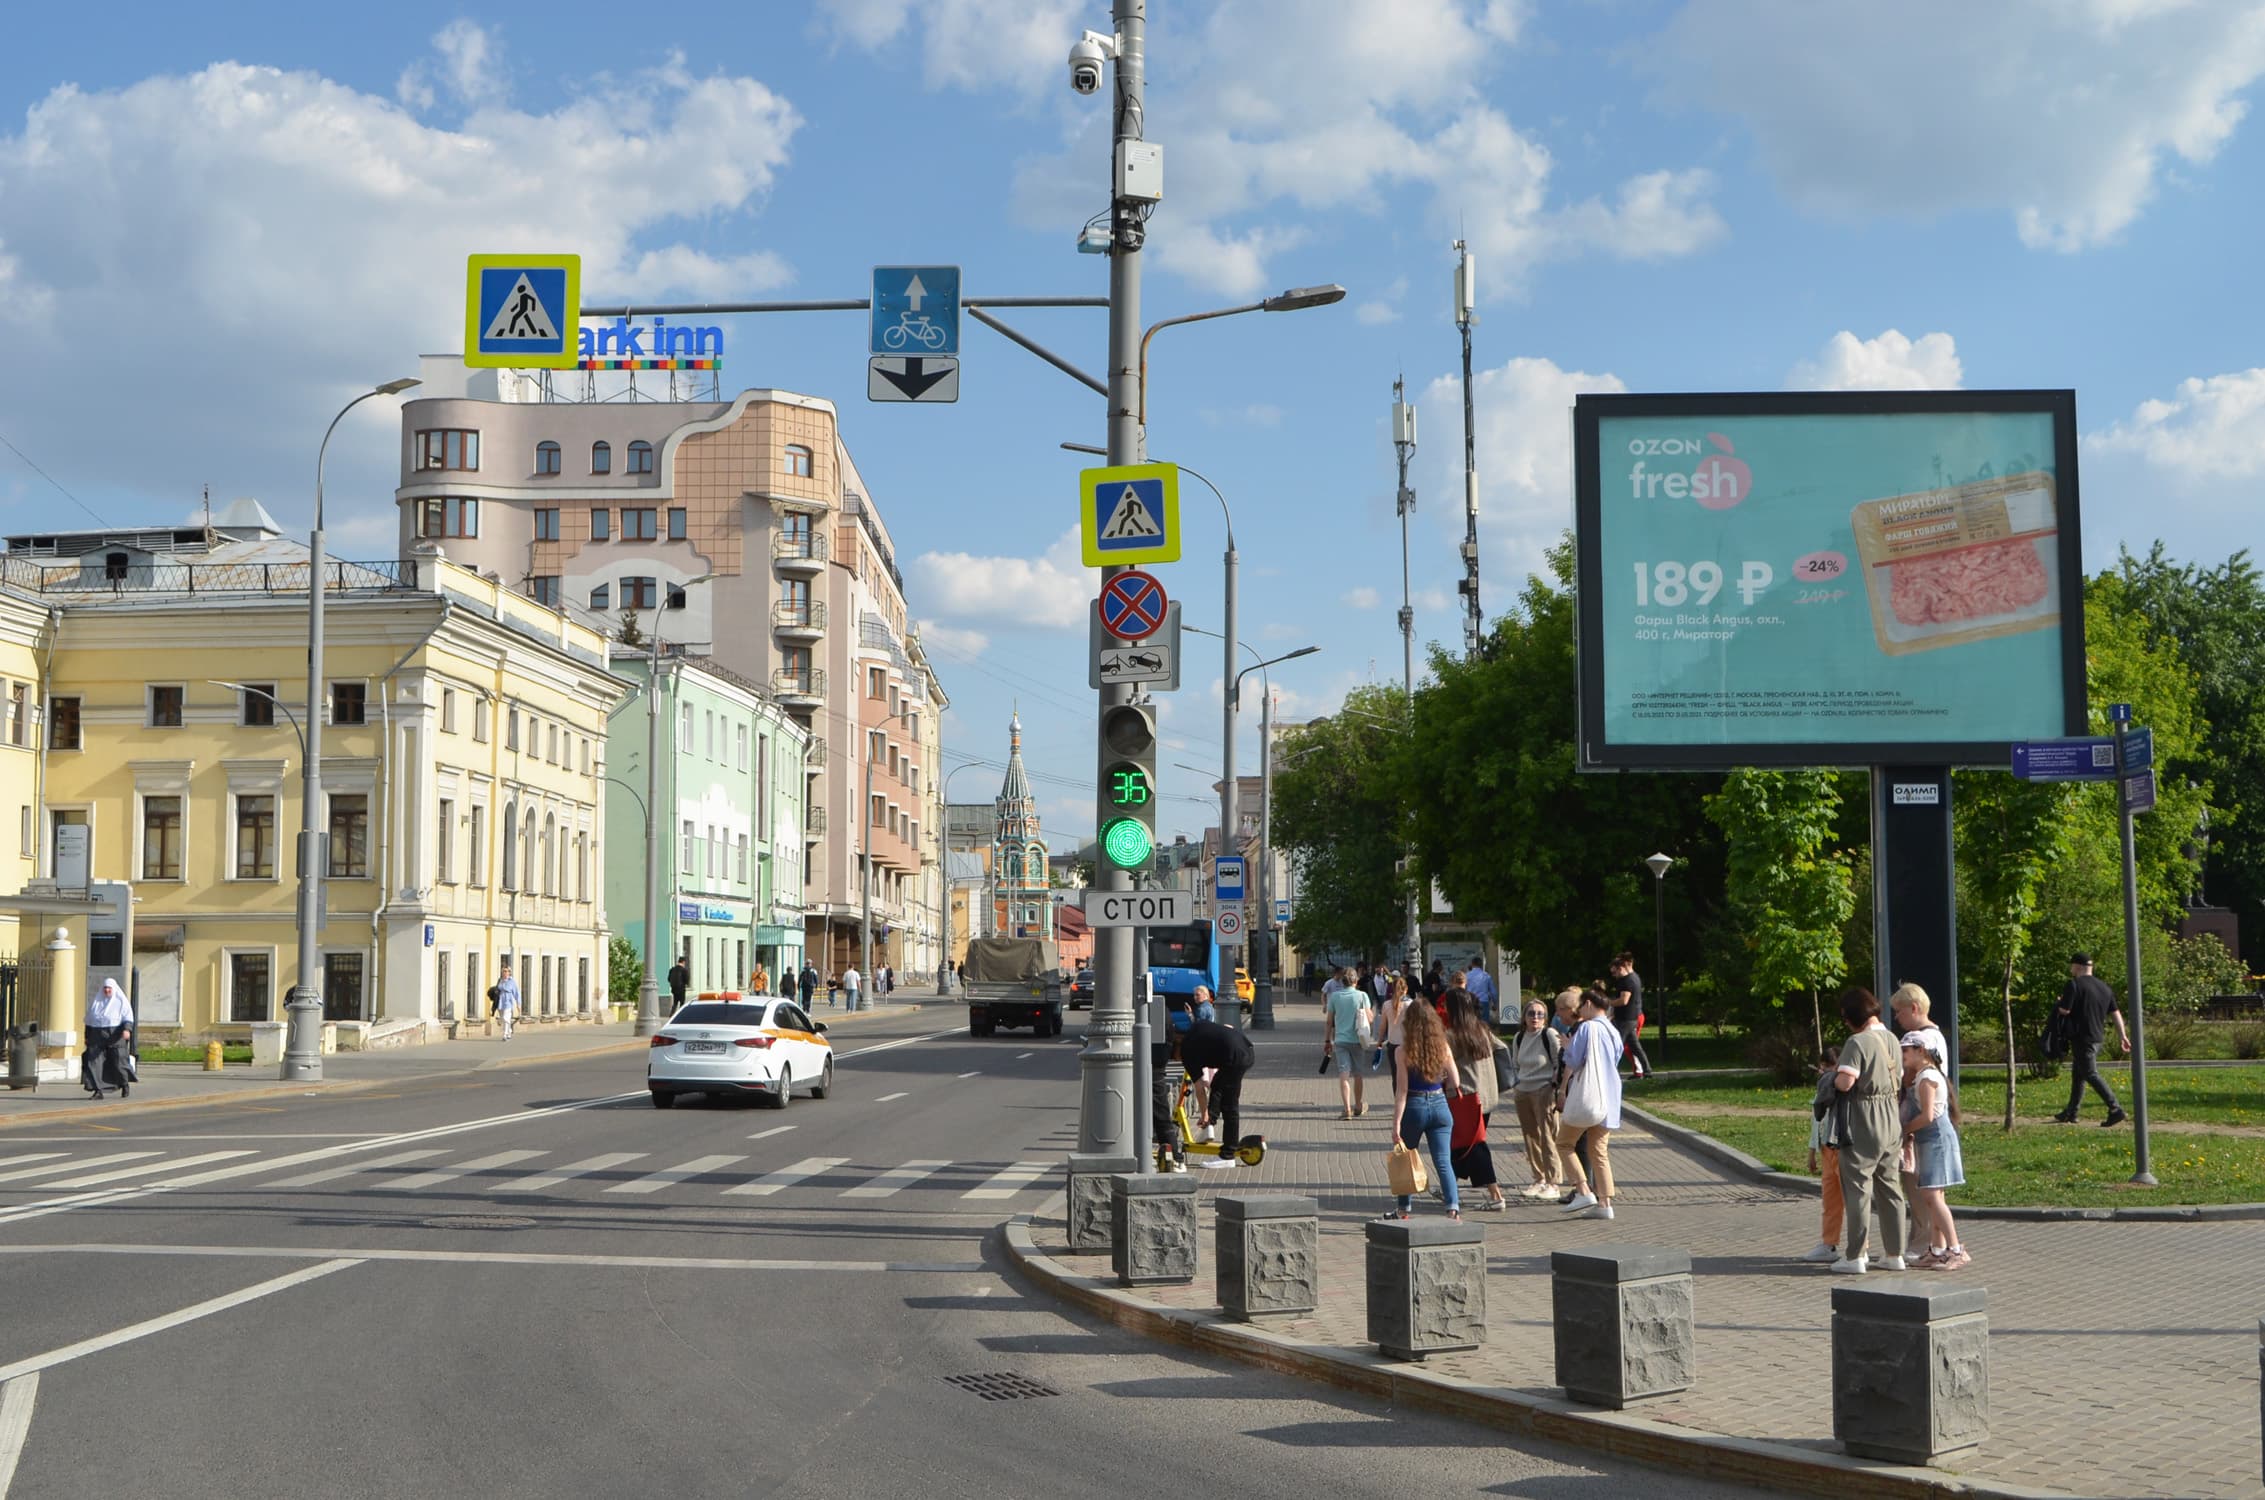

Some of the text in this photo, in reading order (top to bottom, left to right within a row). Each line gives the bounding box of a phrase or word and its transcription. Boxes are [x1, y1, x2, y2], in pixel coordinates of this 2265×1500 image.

[578, 317, 723, 356] ark inn
[1628, 438, 1702, 455] OZON
[1628, 460, 1738, 499] fresh
[1633, 560, 1723, 607] 189
[1634, 614, 1673, 626] Фарш
[1676, 613, 1709, 625] Black
[1712, 613, 1753, 627] Angus,
[1635, 629, 1659, 640] 400
[1673, 629, 1735, 641] Мираторг
[1113, 772, 1147, 803] 36
[1894, 786, 1937, 795] ОЛИМП
[1103, 897, 1174, 921] СТОП
[1223, 918, 1235, 928] 50
